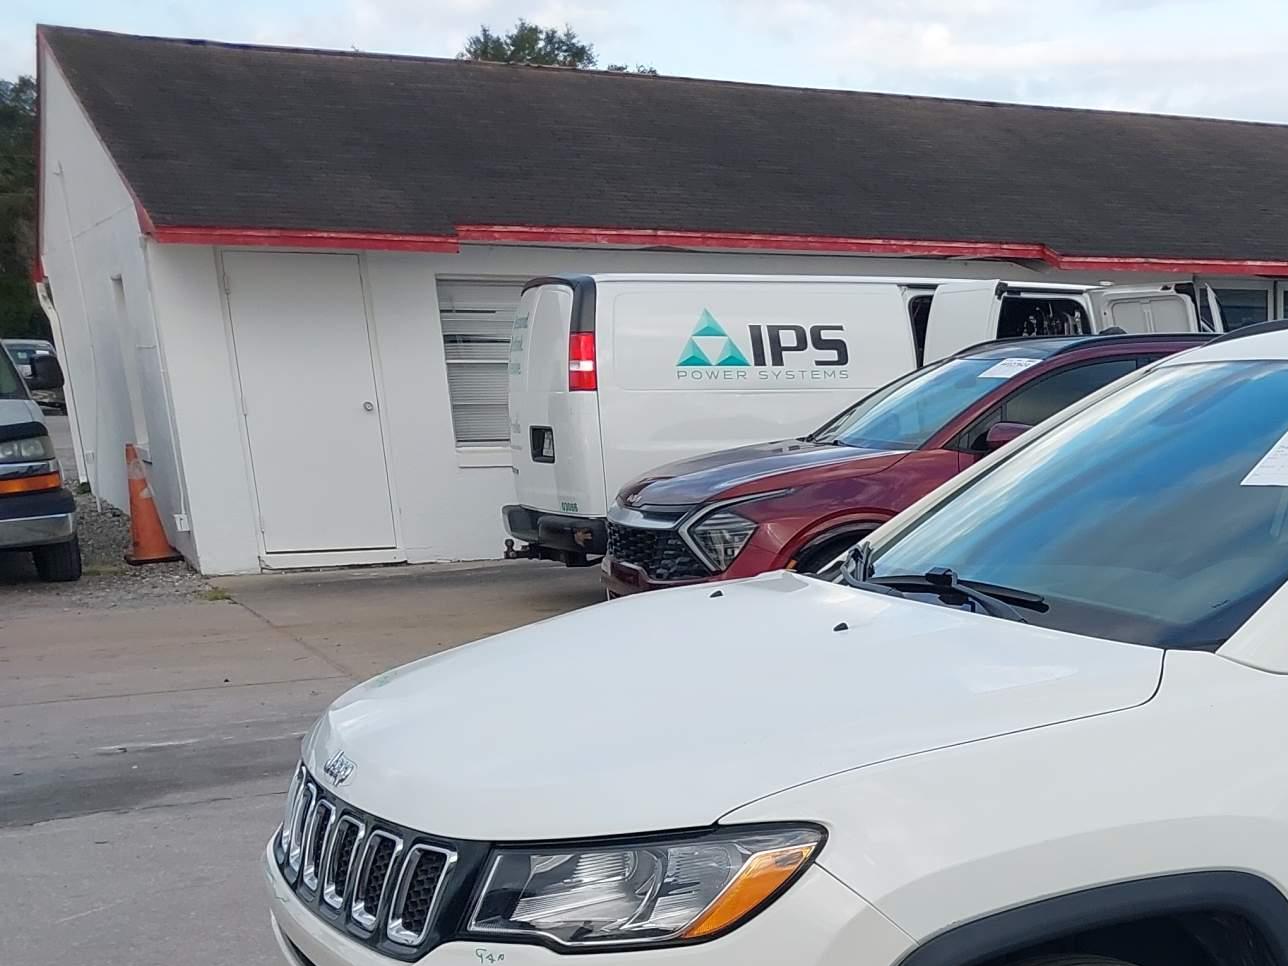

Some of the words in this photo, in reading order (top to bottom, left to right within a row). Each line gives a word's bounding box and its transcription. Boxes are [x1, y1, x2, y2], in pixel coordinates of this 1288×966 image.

[748, 324, 849, 367] IPS
[676, 370, 747, 380] POWER
[758, 369, 849, 380] SYSTEMS
